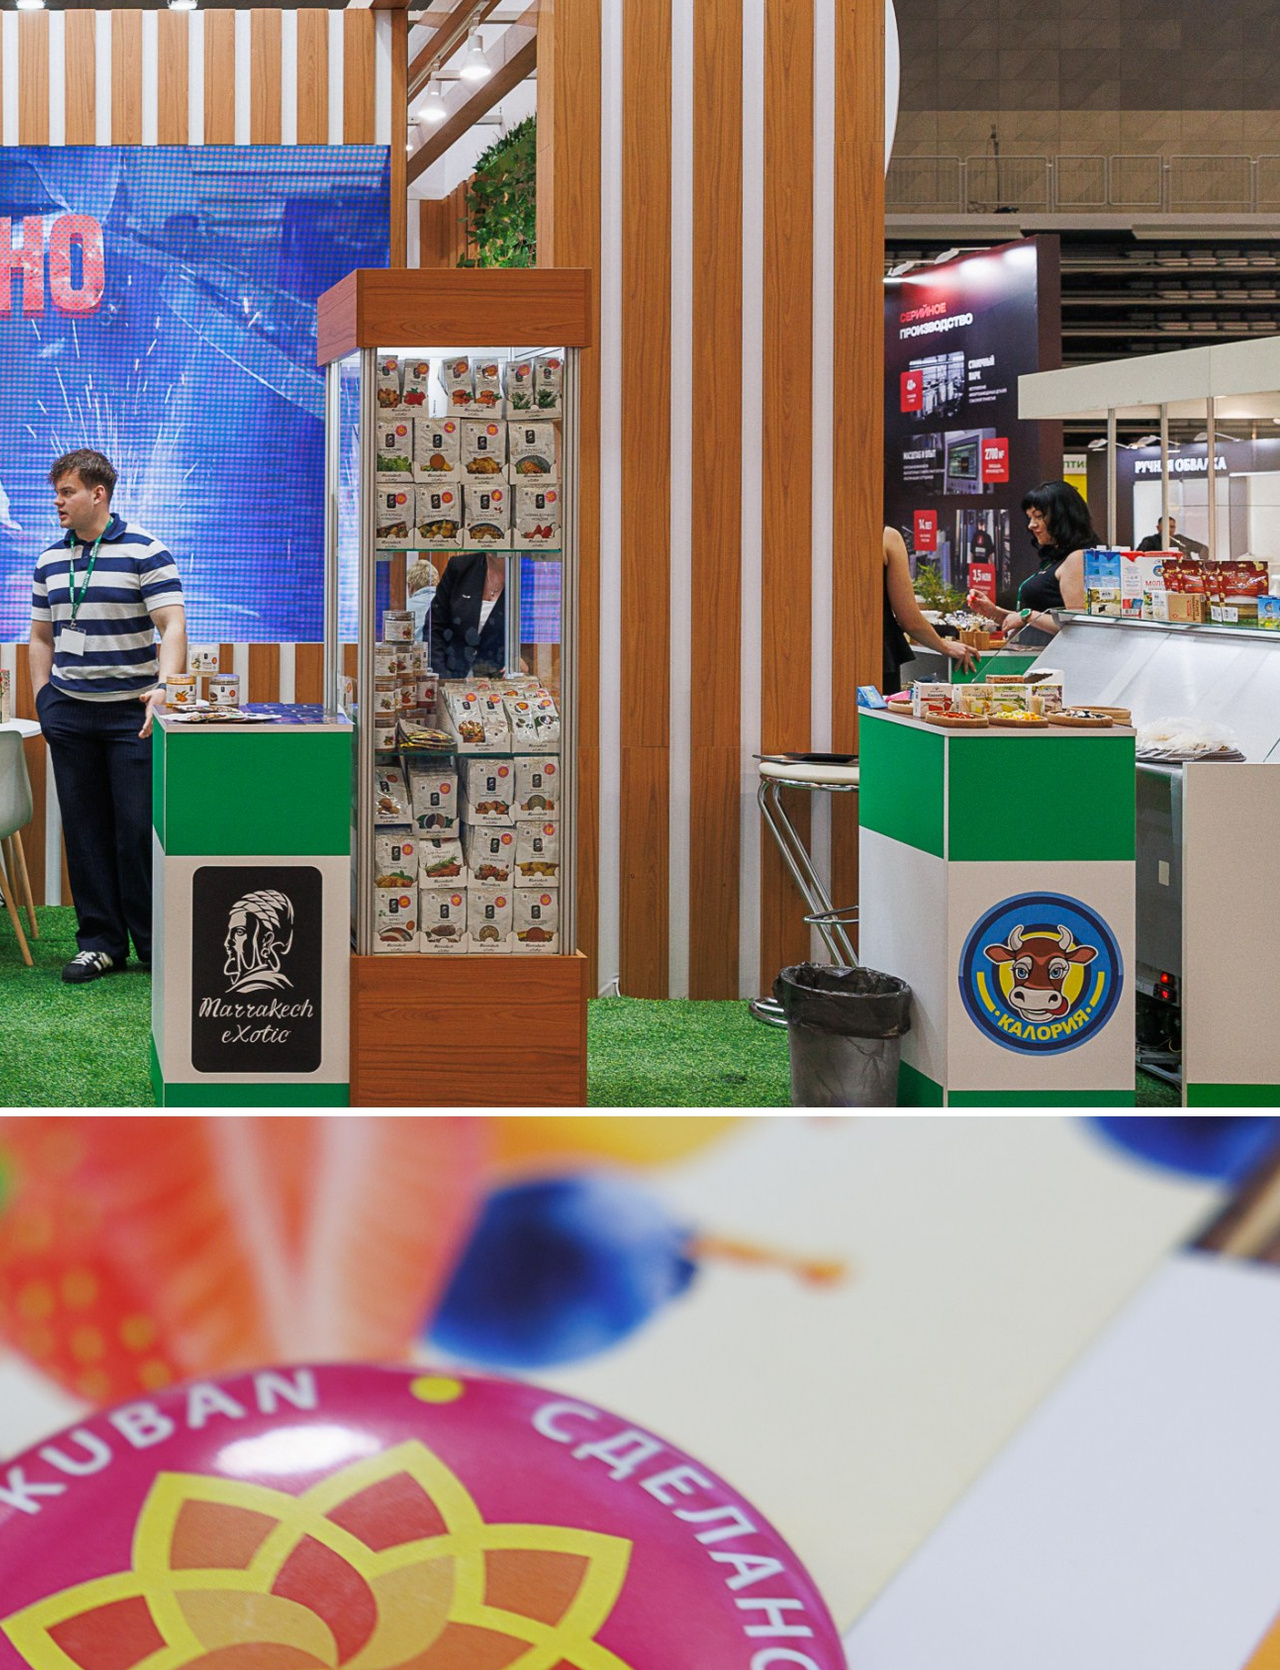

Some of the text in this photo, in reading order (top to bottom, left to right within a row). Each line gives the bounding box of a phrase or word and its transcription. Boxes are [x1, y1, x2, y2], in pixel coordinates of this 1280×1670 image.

[900, 302, 947, 323] СЕРИЙНОЕ
[899, 312, 974, 340] ПРОИЗВОДСТВО
[1134, 456, 1227, 473] РУЧНЯ ОБВАКА
[199, 997, 314, 1020] Marrakech
[997, 1011, 1090, 1041] КАЛОРИЯ
